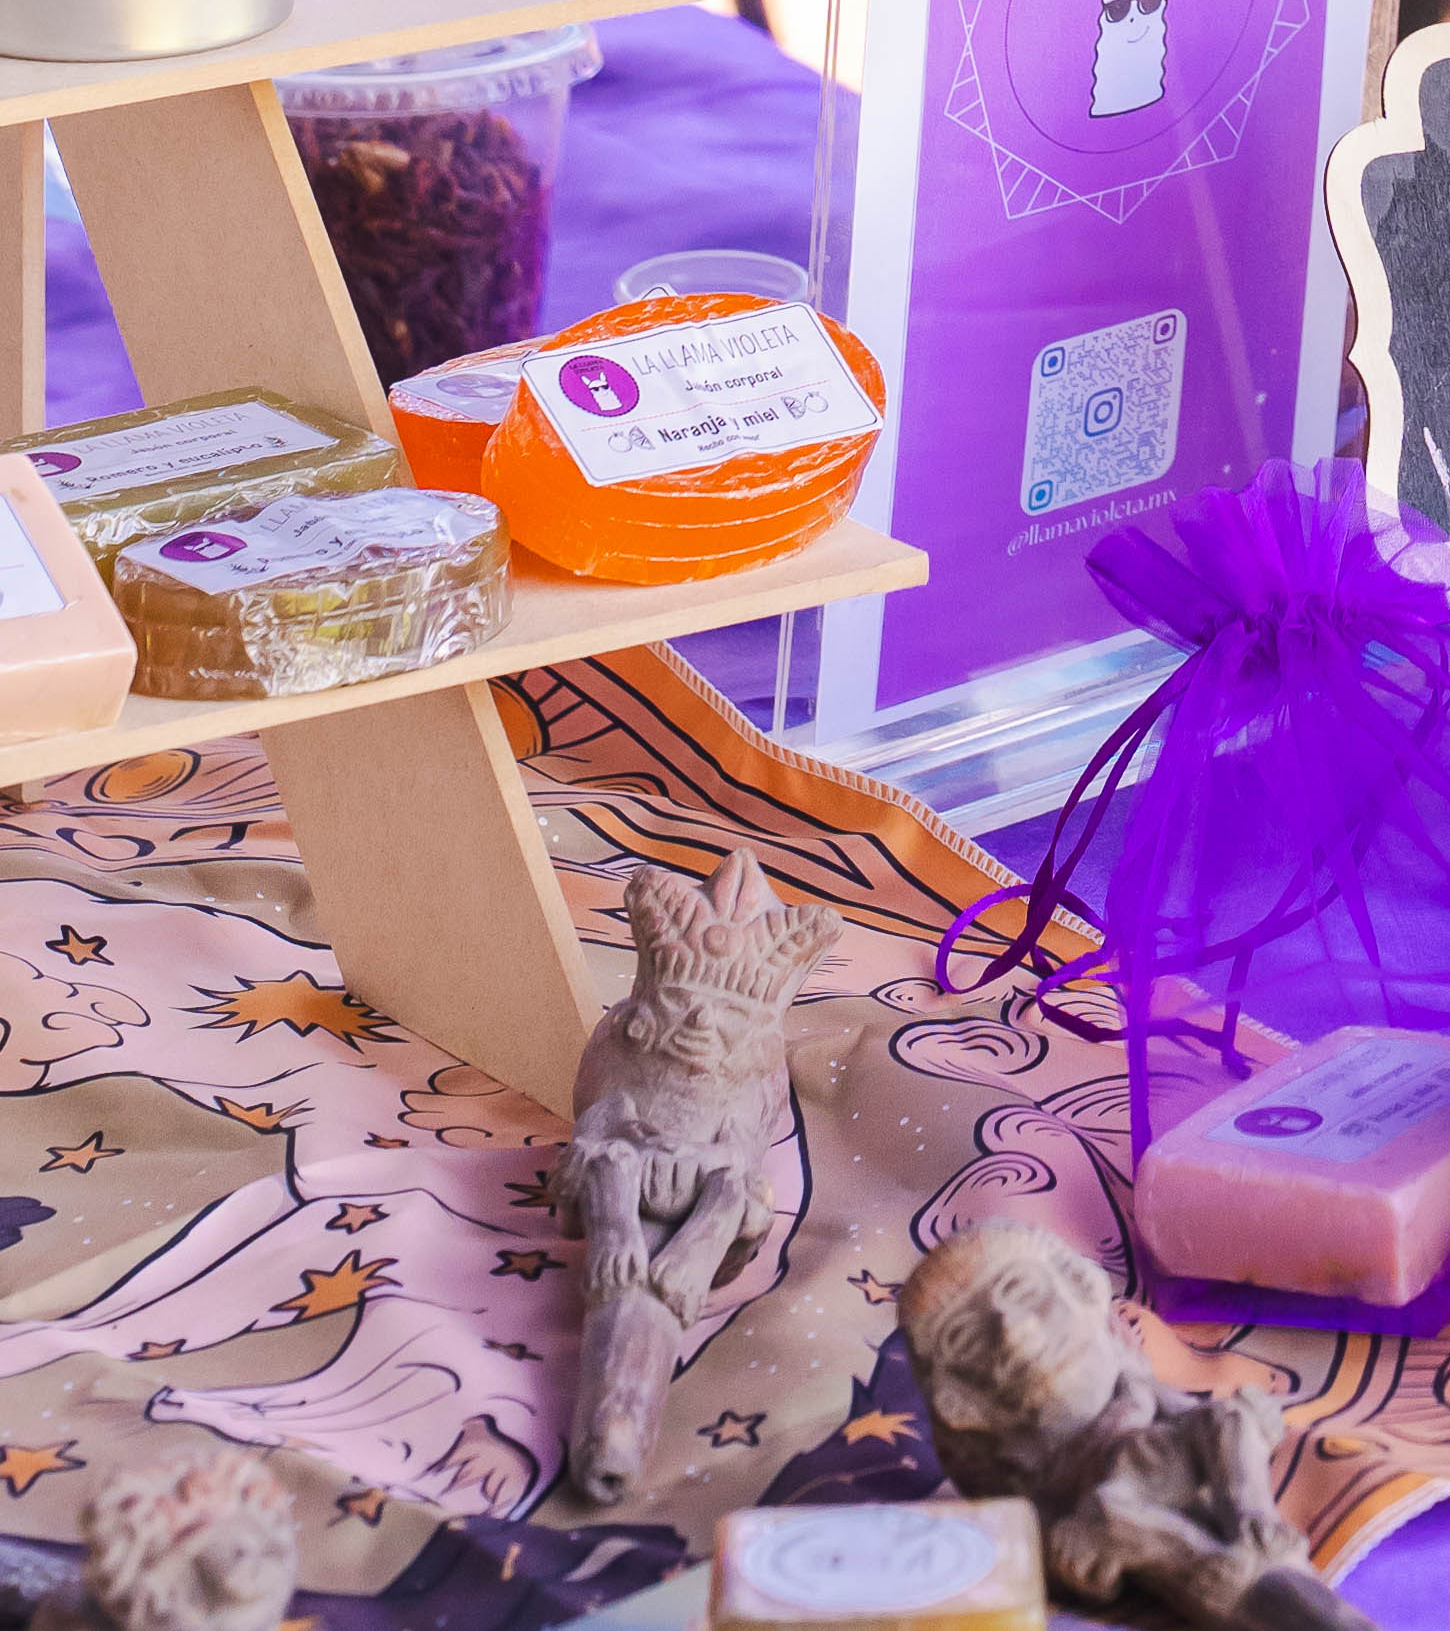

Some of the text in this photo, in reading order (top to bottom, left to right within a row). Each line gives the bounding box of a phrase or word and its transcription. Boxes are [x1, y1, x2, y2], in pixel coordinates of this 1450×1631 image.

[632, 354, 661, 376] LA
[658, 343, 723, 370] LLAMA
[720, 324, 800, 359] VIOLETA
[724, 366, 783, 388] corporal
[167, 411, 250, 434] VIOLETA
[658, 415, 727, 443] Naranja
[742, 407, 779, 427] miel
[86, 463, 157, 483] Romero
